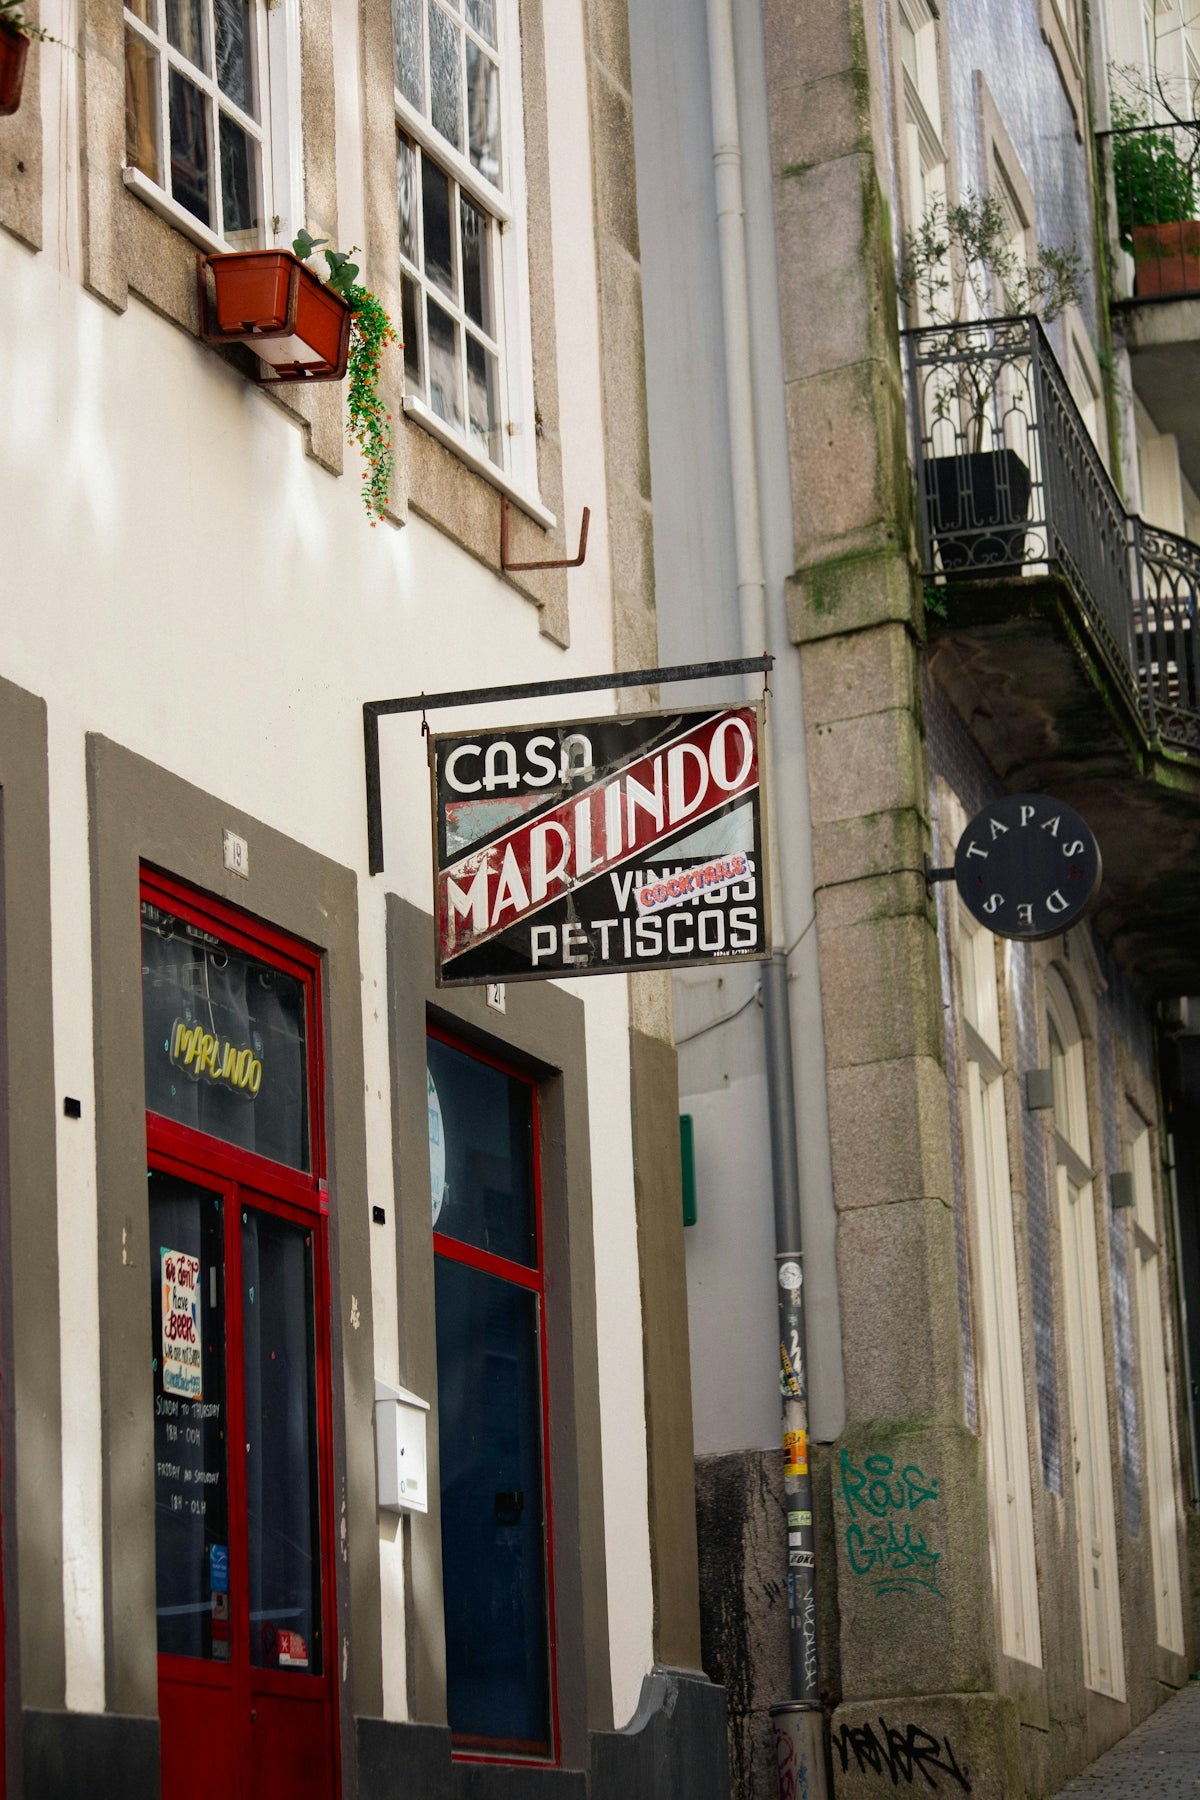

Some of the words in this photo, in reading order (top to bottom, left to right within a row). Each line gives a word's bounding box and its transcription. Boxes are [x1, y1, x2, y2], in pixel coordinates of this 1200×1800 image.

[444, 733, 596, 794] CASA
[446, 716, 754, 952] MARLINDO
[966, 805, 1085, 860] TAPAS
[639, 855, 747, 908] COCKTAILS
[530, 906, 758, 966] PETISCOS
[174, 1023, 262, 1093] MARLINDO
[172, 1286, 188, 1311] have
[156, 1394, 179, 1416] SUNDAY
[157, 1462, 180, 1480] FRIDAY
